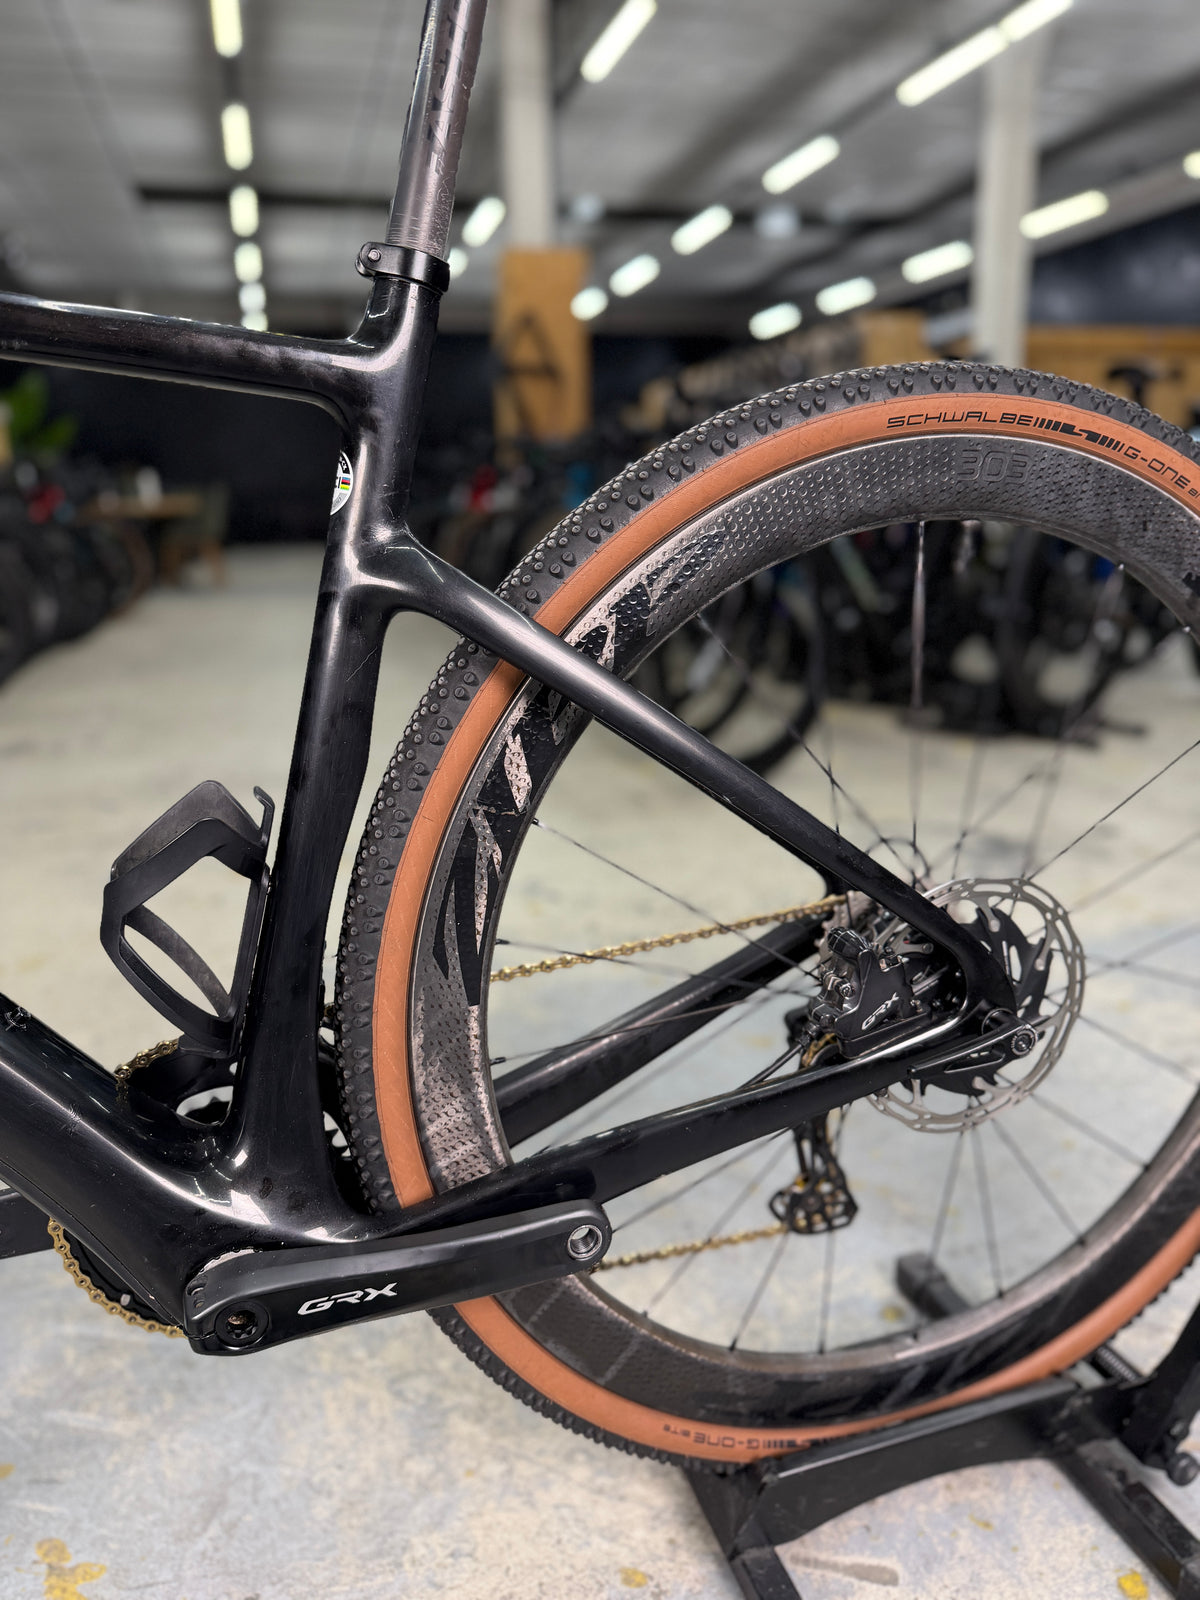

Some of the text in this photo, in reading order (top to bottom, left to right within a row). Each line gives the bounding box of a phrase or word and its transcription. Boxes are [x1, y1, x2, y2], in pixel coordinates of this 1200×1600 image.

[886, 411, 1034, 427] SCHWALBE
[1123, 446, 1191, 490] G-ONE
[956, 449, 1033, 486] 303
[862, 992, 899, 1031] GRX
[298, 1282, 397, 1315] GRX
[694, 1431, 759, 1450] G-ONE
